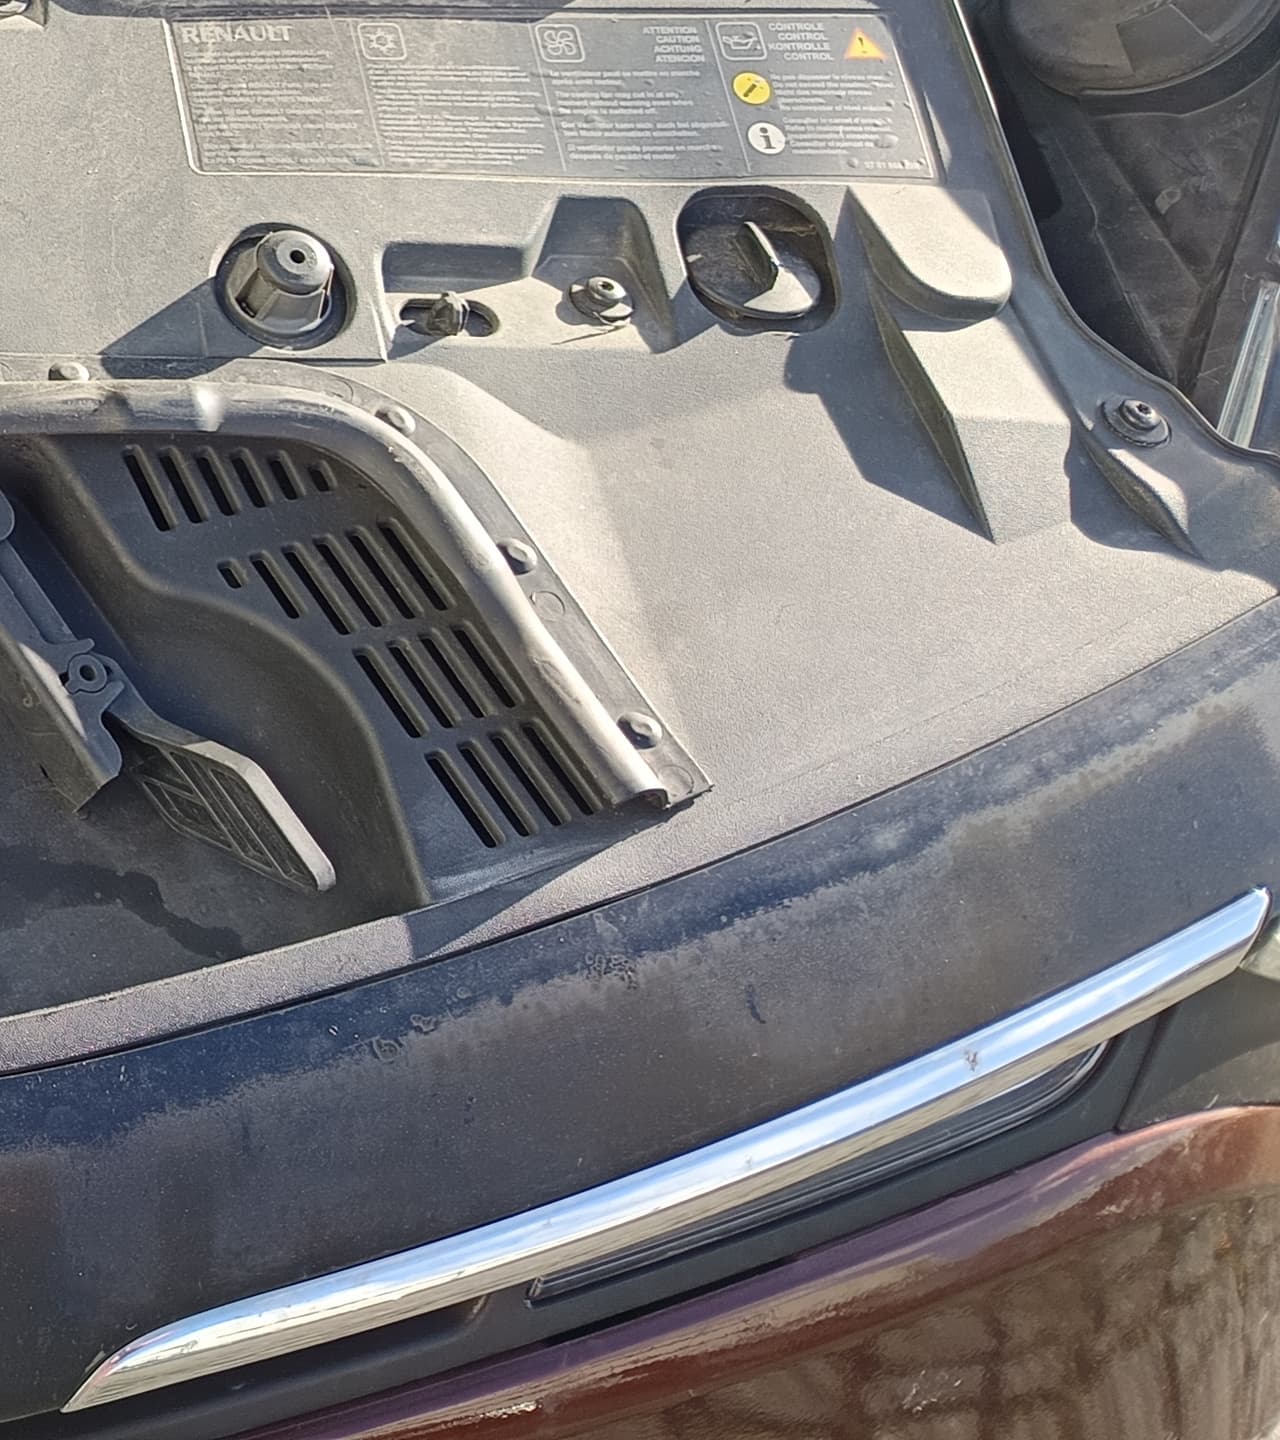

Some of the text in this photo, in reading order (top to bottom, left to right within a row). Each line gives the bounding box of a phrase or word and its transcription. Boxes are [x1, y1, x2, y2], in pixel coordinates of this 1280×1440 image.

[641, 26, 698, 34] ATTENTION
[767, 22, 825, 30] CONTROLE
[181, 24, 294, 44] RENAULT
[776, 32, 828, 40] CONTROL
[655, 35, 700, 43] CAUTION
[767, 42, 831, 50] KONTROLLE
[782, 52, 835, 60] CONTROL
